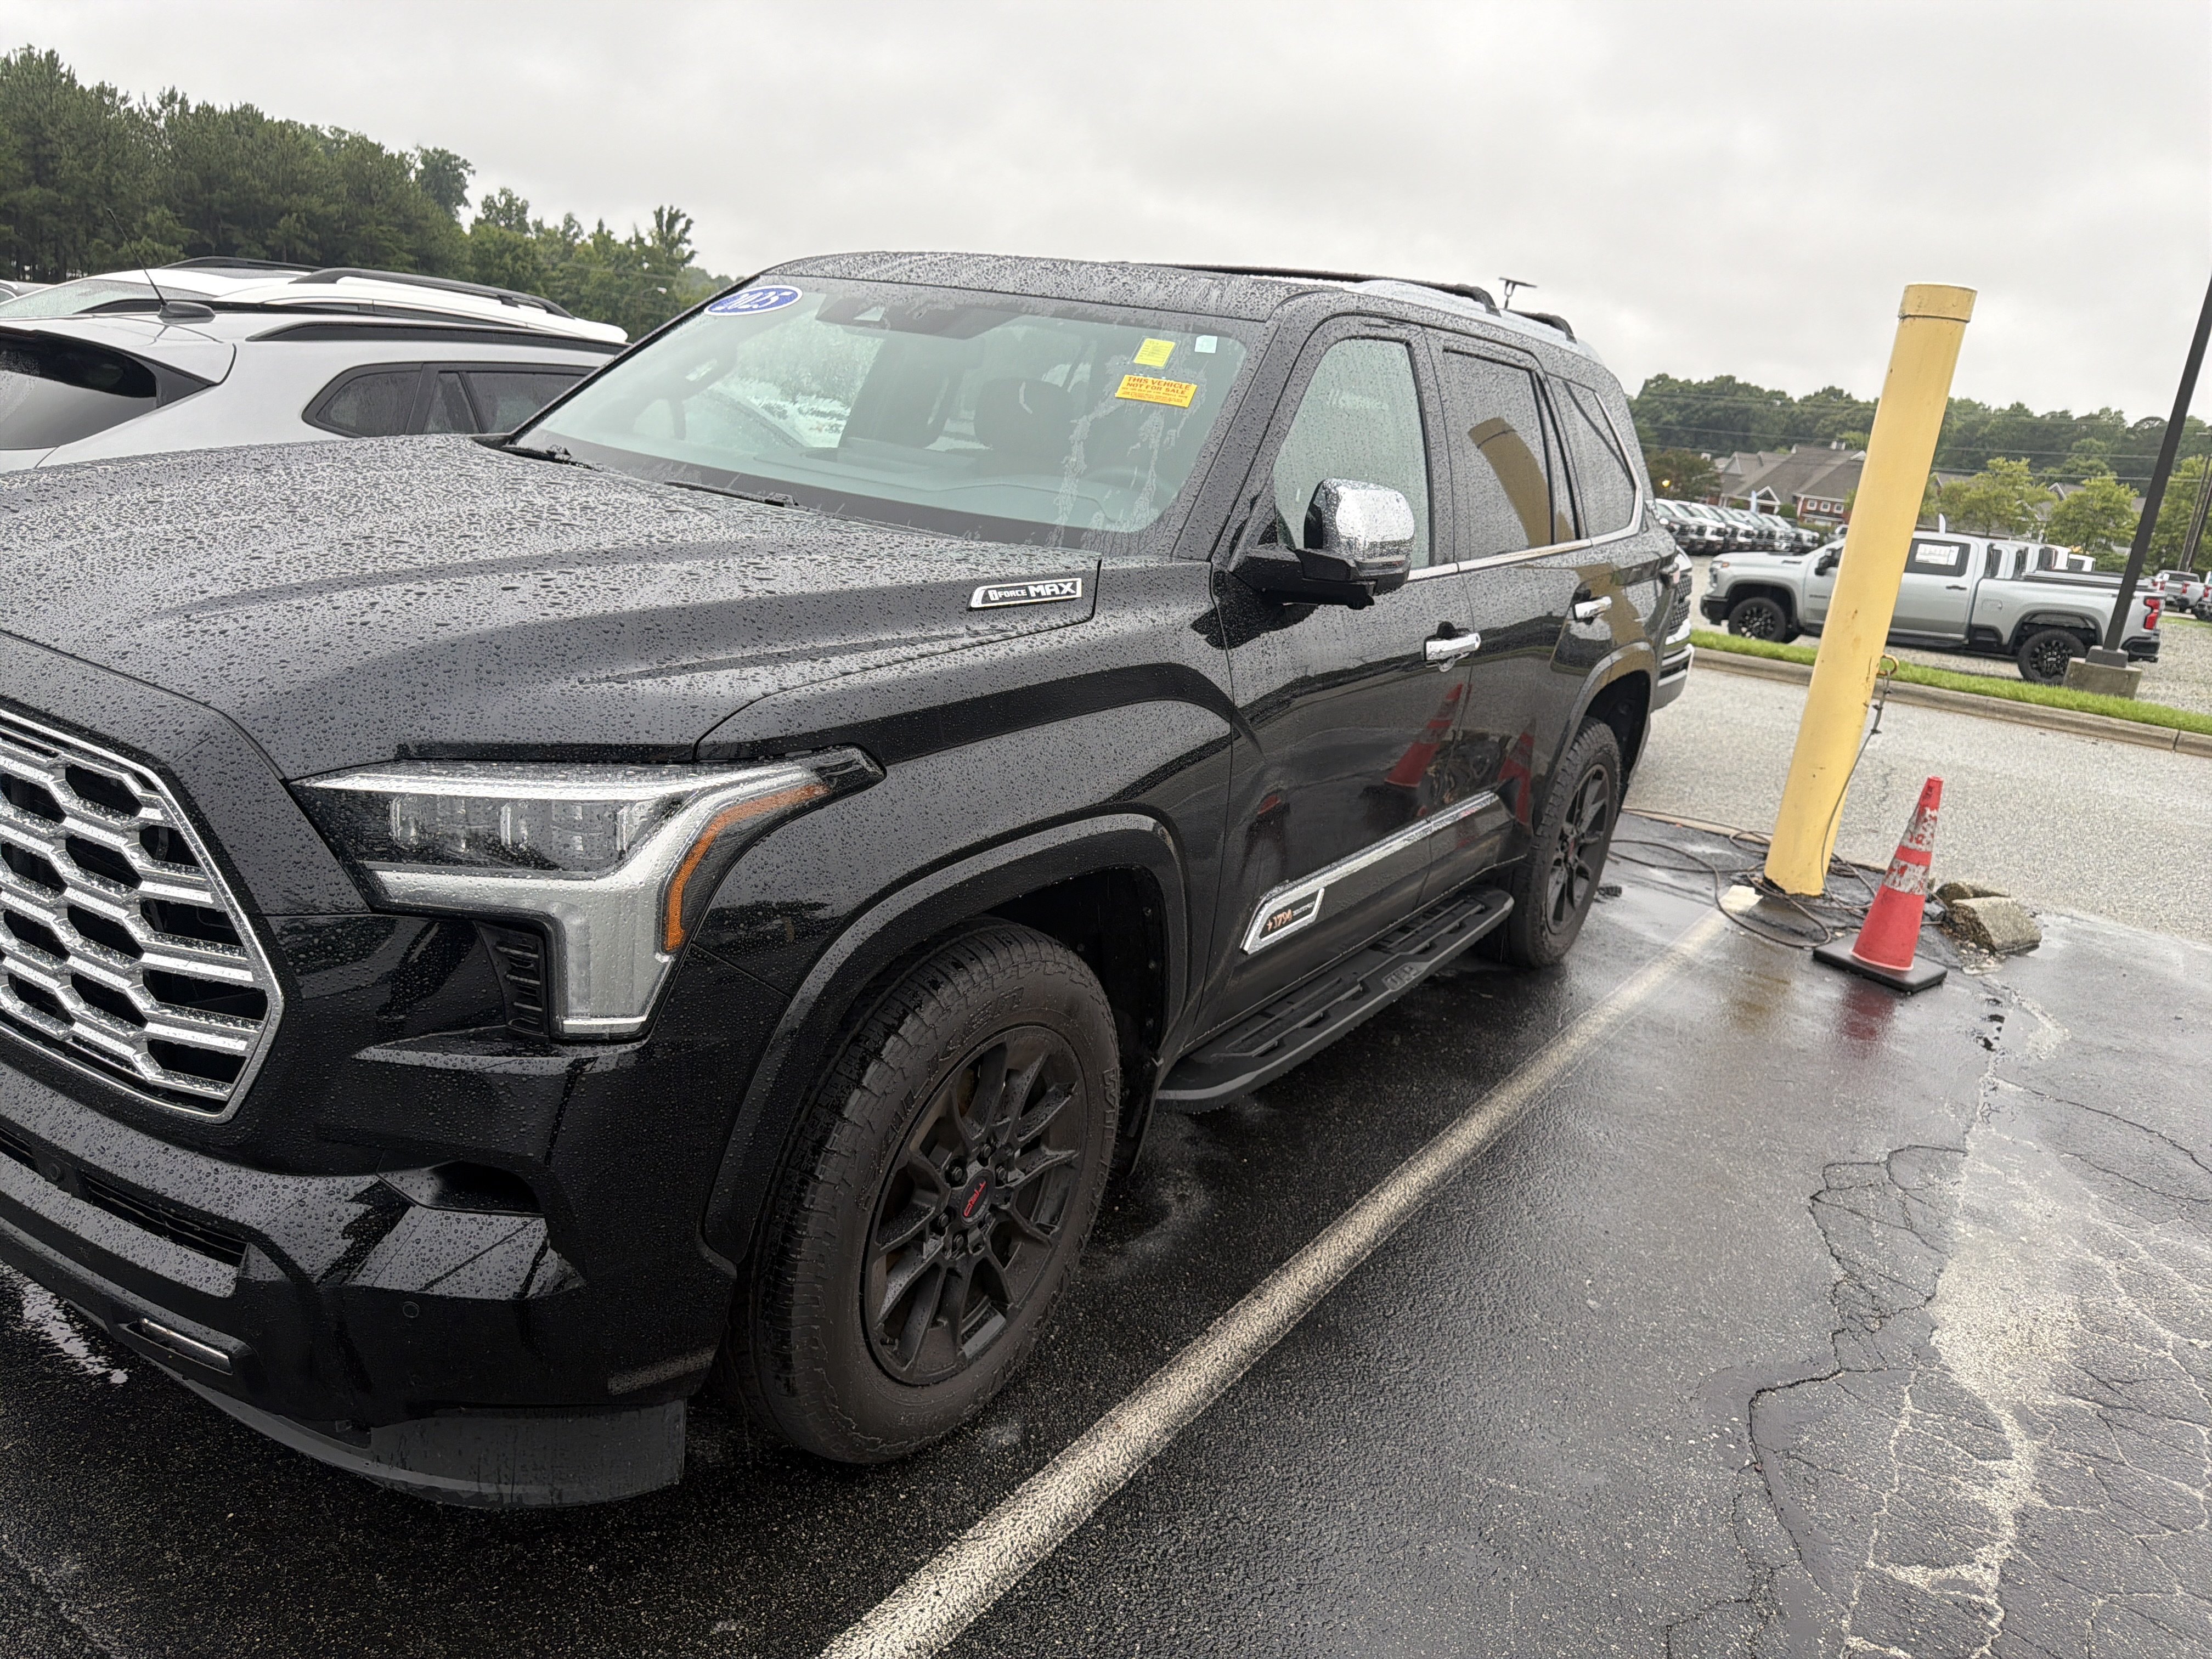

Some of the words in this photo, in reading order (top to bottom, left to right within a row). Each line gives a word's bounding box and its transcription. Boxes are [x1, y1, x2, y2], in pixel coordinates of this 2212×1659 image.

[712, 291, 793, 311] 2025
[1152, 380, 1191, 390] VEHICLE
[1029, 582, 1075, 597] MAX
[1273, 909, 1293, 929] 1794
